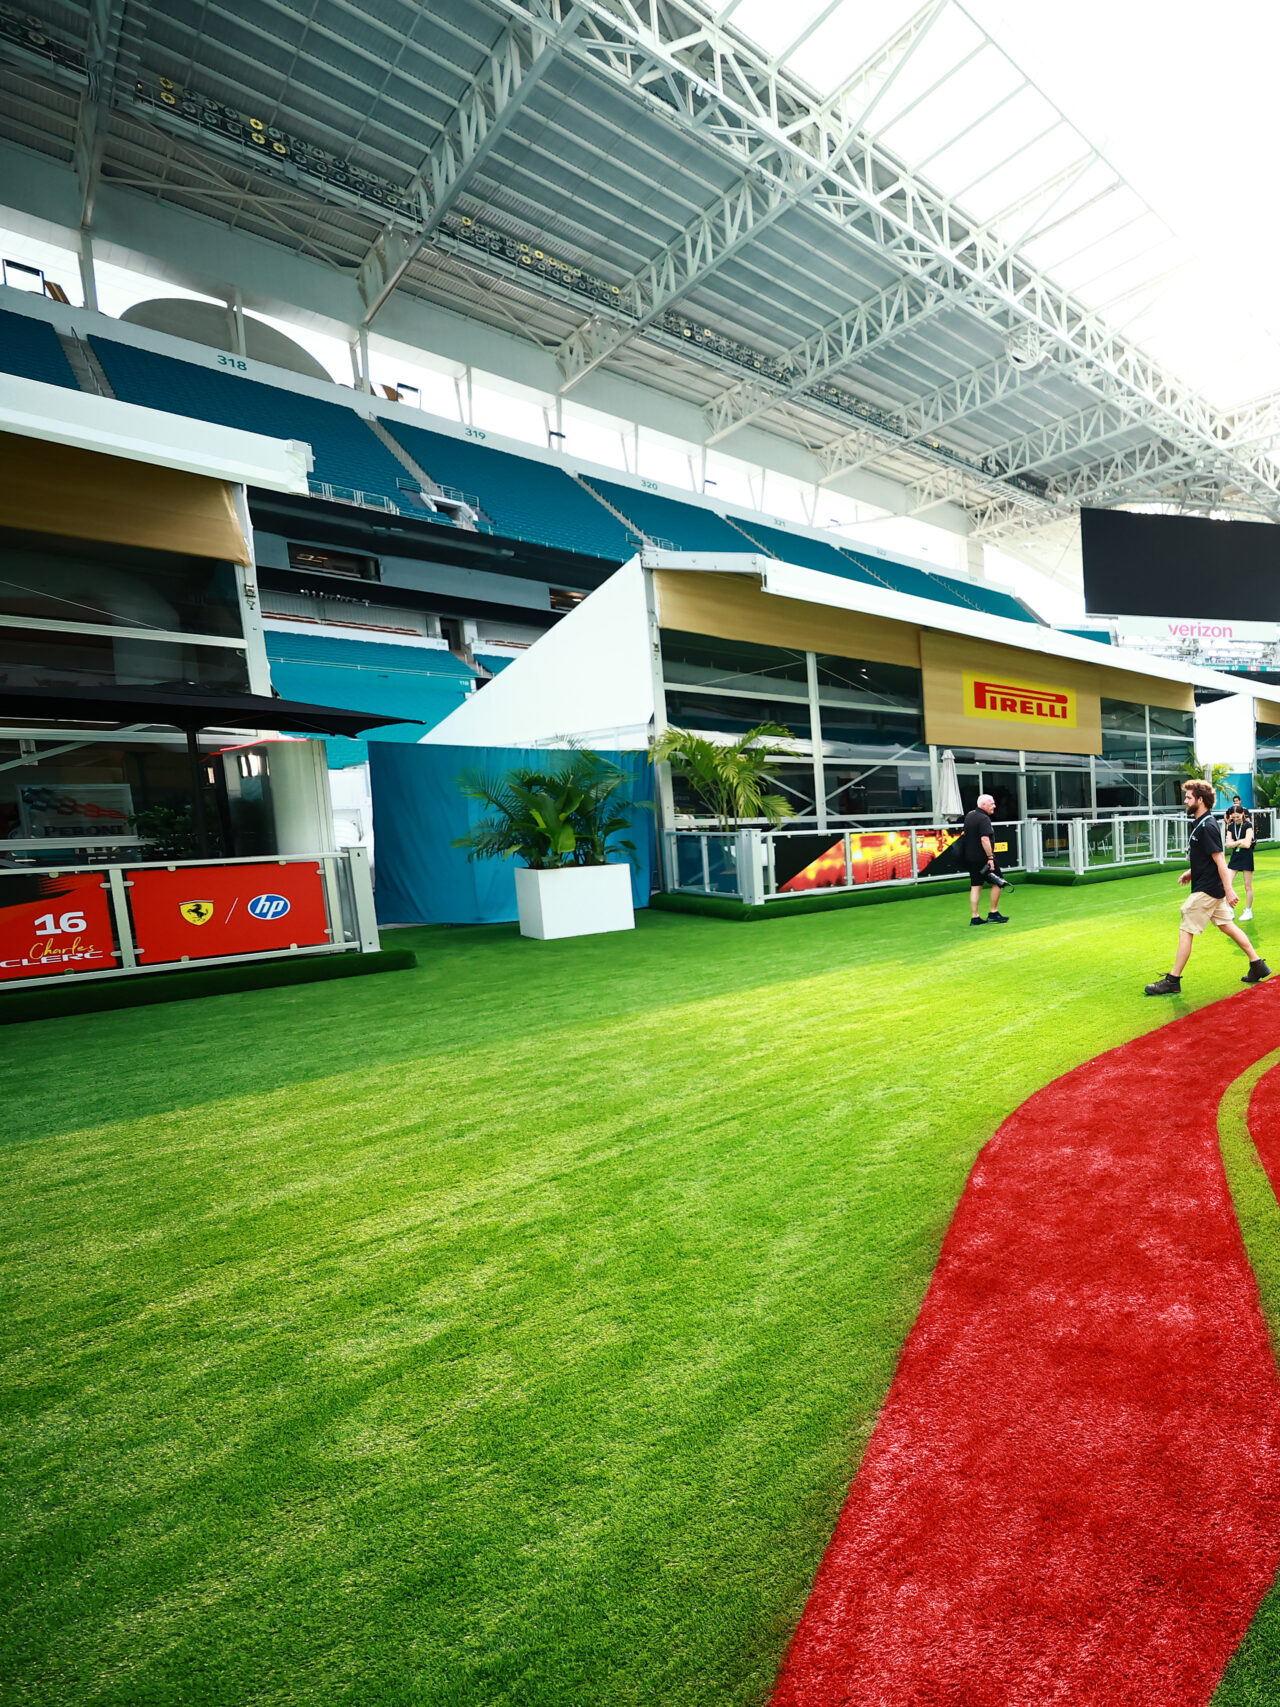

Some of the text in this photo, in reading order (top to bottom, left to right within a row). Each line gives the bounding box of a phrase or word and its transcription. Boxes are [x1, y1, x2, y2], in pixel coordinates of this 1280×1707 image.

[217, 354, 247, 371] 318
[465, 427, 486, 440] 319
[640, 480, 658, 490] 320
[1168, 621, 1233, 639] verizon
[973, 680, 1069, 720] PIRELLI
[254, 894, 286, 920] hp
[34, 911, 87, 936] 16
[29, 936, 95, 960] Charles
